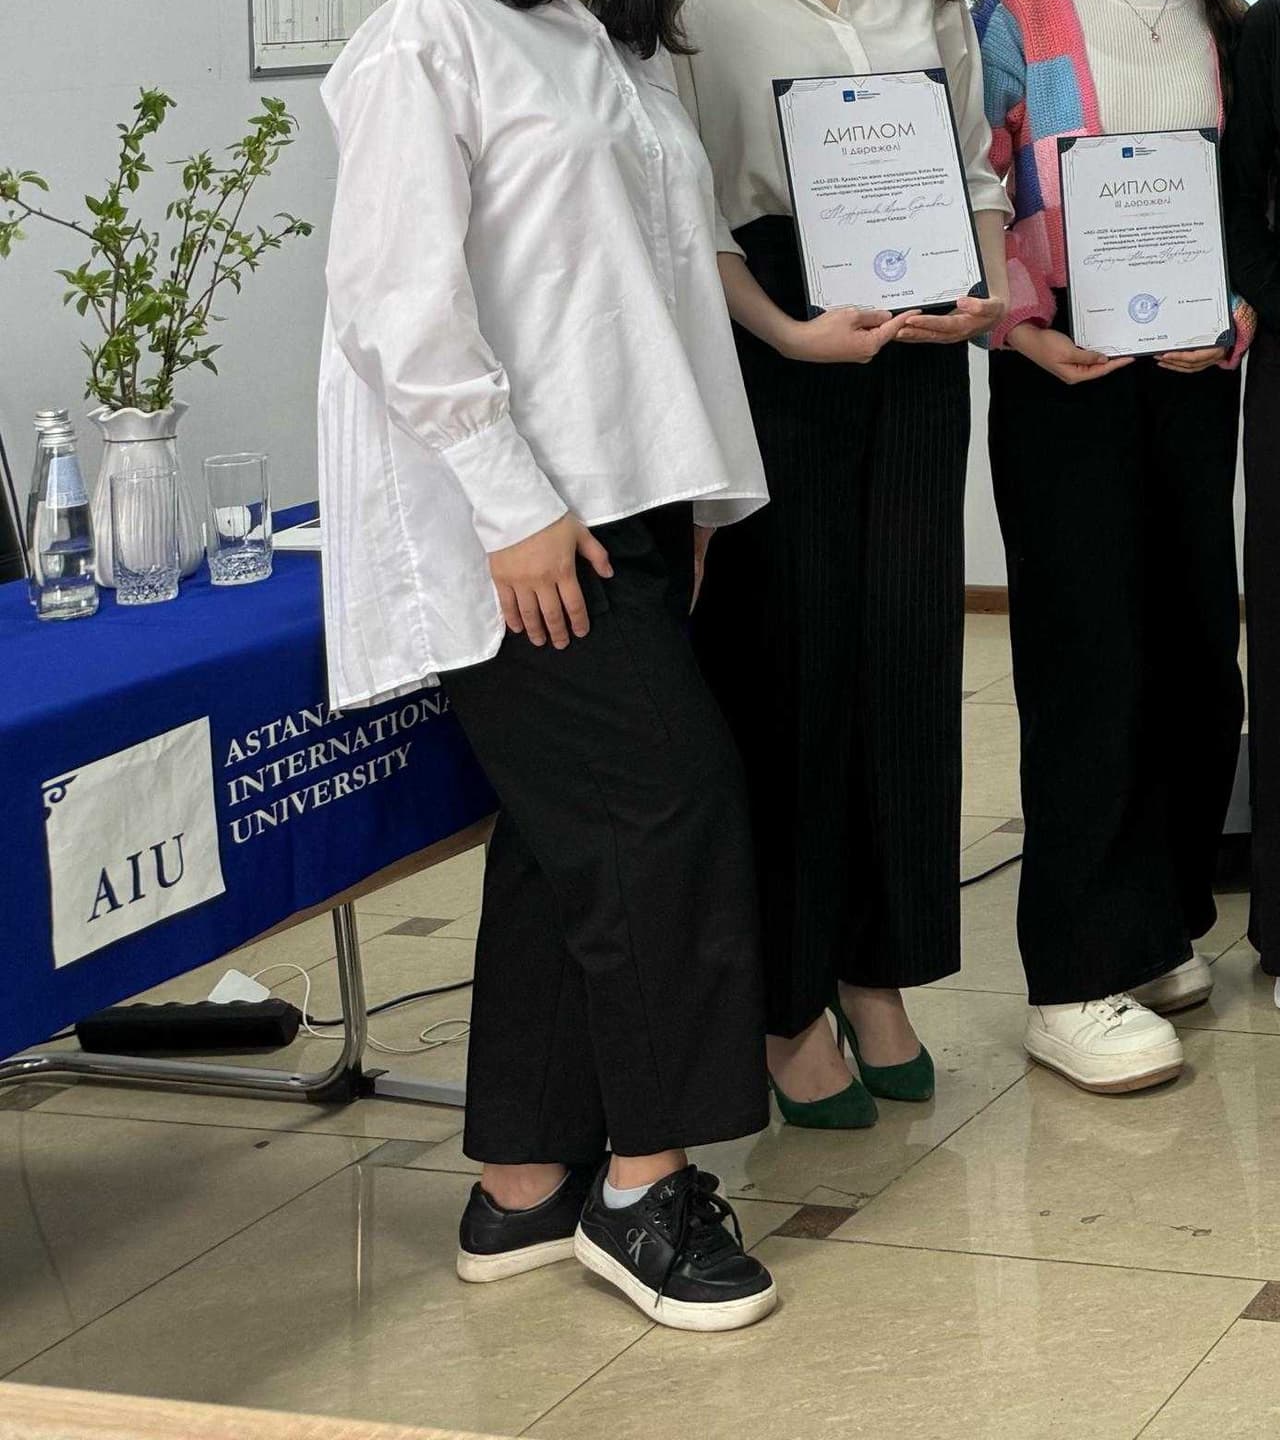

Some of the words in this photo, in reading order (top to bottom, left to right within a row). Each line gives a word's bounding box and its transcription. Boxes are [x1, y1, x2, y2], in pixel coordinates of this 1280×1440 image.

[824, 122, 916, 145] ДИПЛОМ
[1099, 177, 1185, 198] ДИПЛОМ
[229, 742, 412, 845] UNIVERSITY
[87, 832, 186, 924] AIU
